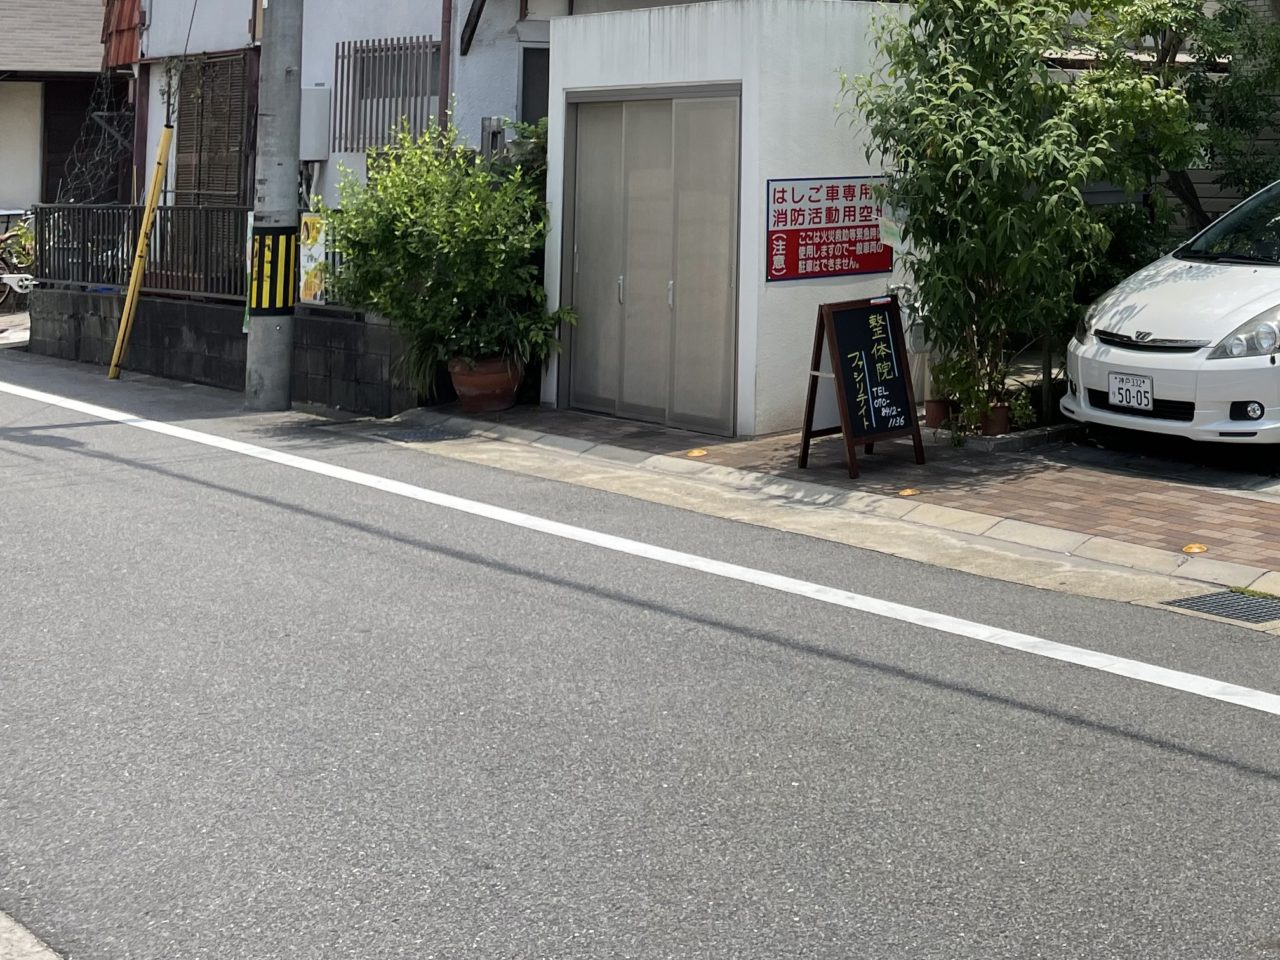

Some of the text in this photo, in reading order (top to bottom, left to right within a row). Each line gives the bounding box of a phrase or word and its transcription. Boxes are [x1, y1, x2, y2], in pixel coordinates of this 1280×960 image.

[773, 184, 885, 205] はしご車専用
[869, 314, 893, 382] 整体院
[872, 386, 889, 397] TEL
[1118, 387, 1150, 407] 50-05
